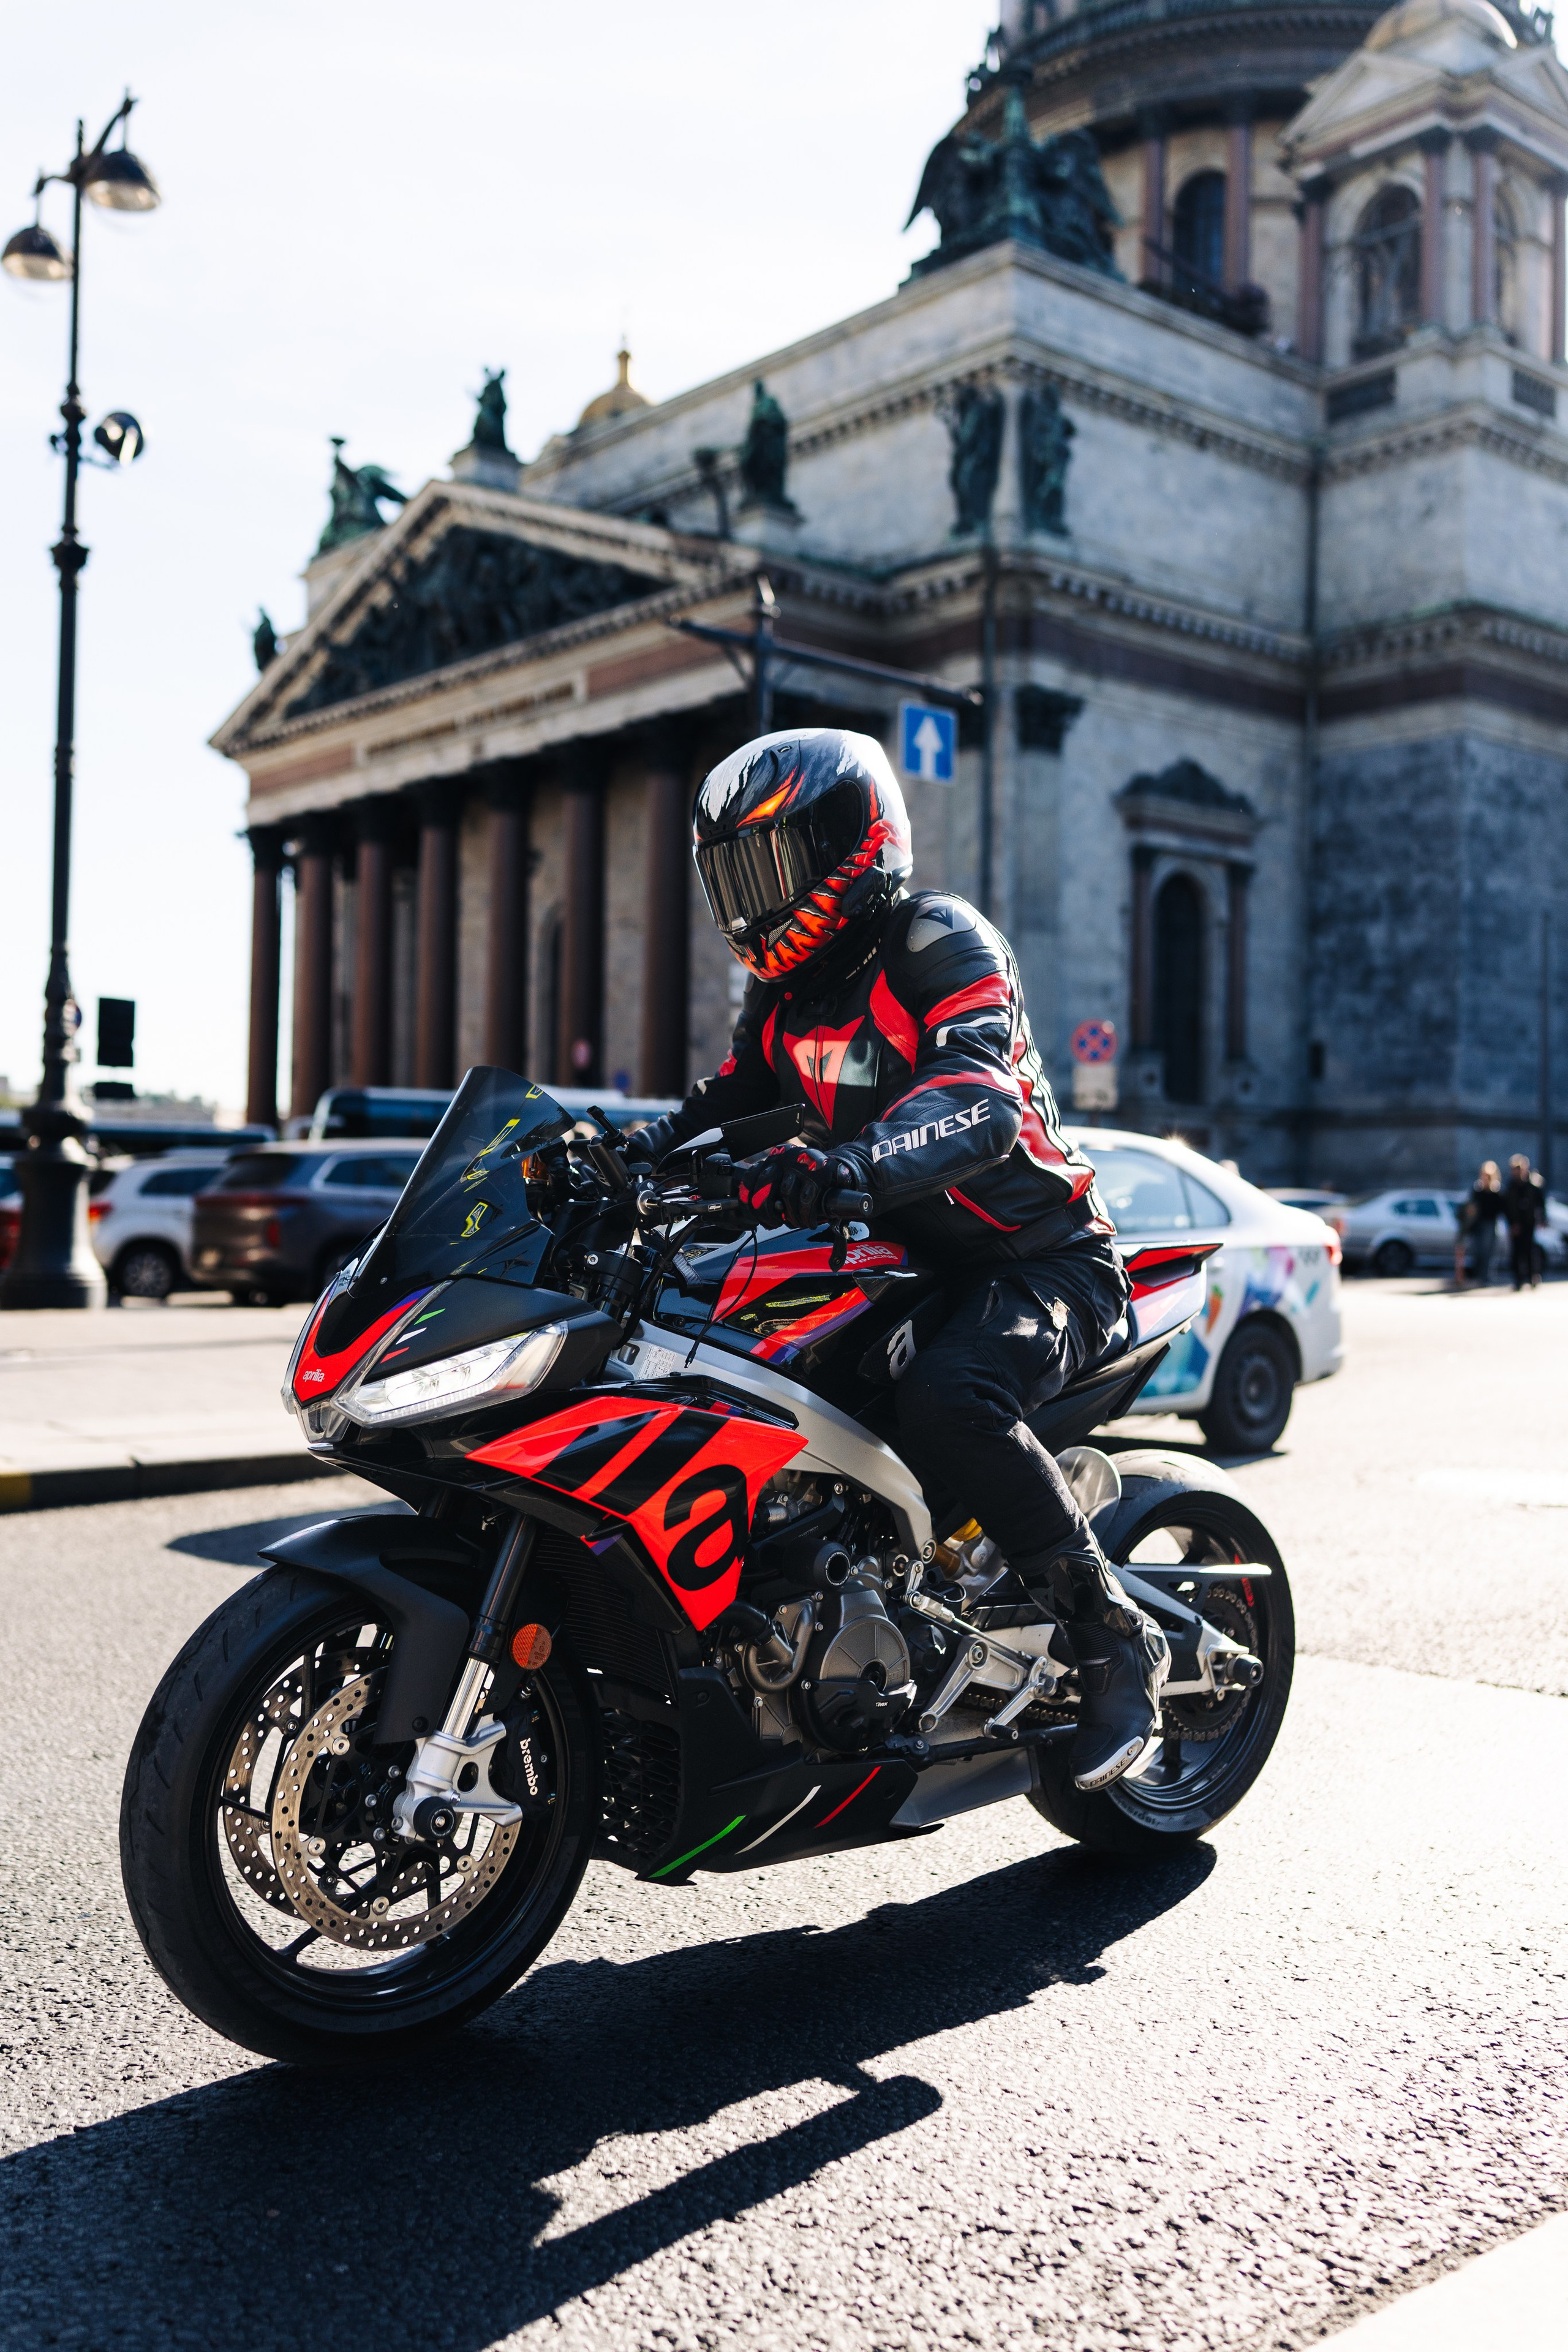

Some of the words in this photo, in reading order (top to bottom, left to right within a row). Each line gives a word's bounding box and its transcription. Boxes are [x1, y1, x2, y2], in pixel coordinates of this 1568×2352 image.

[872, 1098, 990, 1163] DAINESE
[844, 1244, 894, 1265] prilia
[858, 1254, 899, 1263] RACING
[303, 1368, 325, 1382] aprilia
[519, 1737, 538, 1796] brembo
[1090, 1758, 1126, 1787] DAINESE
